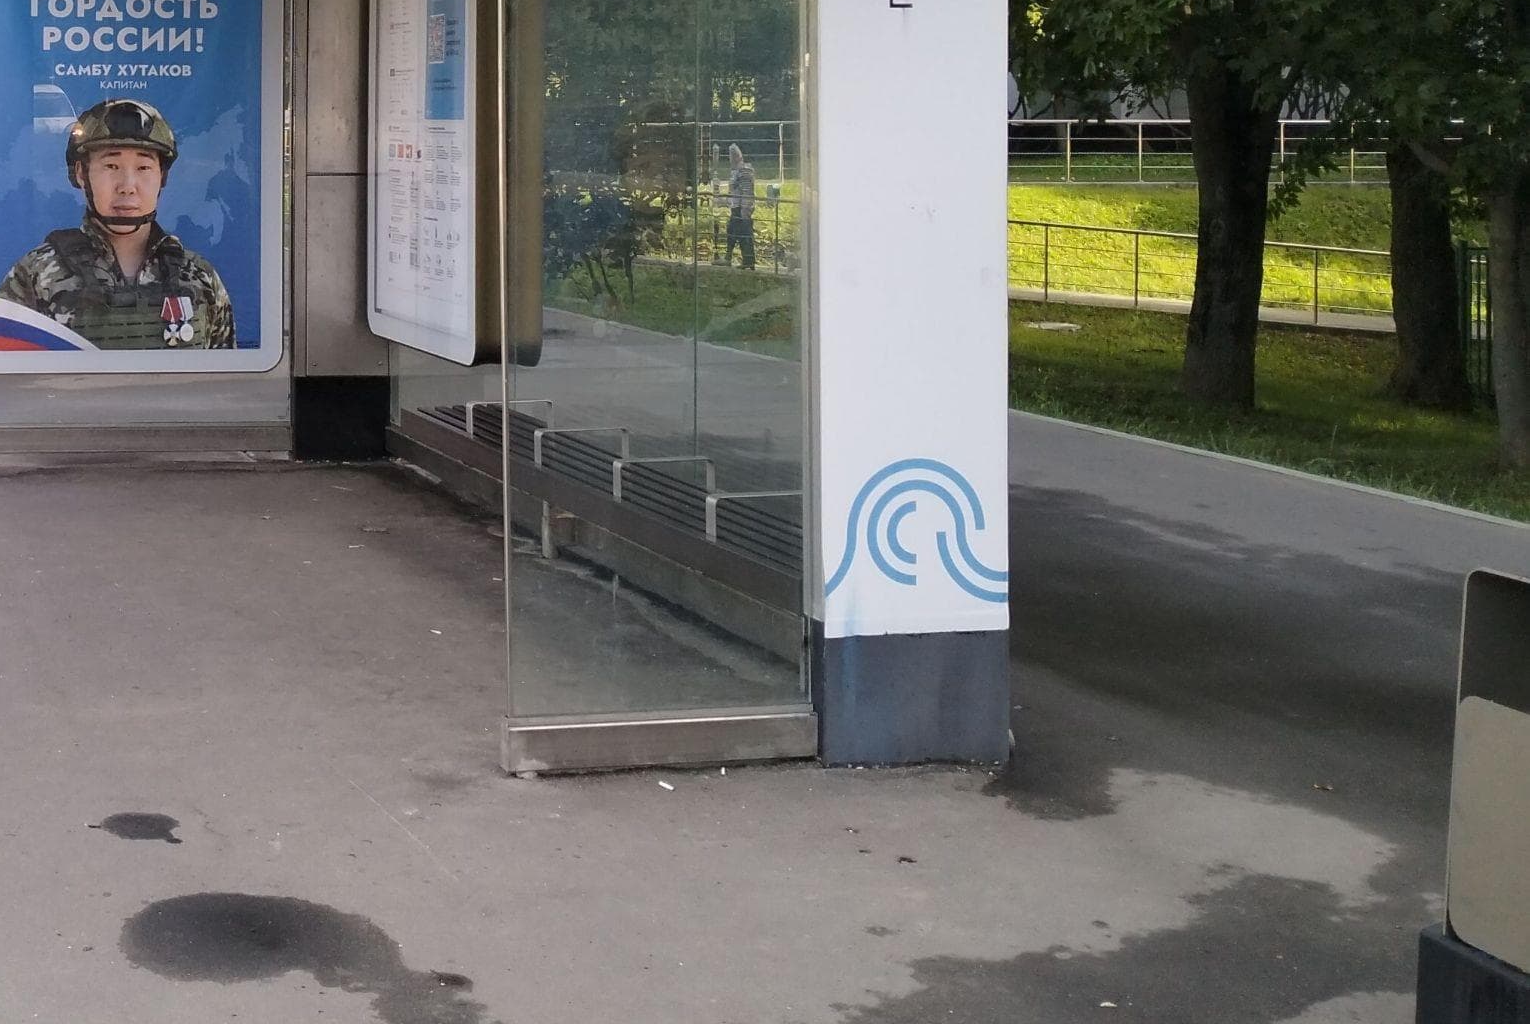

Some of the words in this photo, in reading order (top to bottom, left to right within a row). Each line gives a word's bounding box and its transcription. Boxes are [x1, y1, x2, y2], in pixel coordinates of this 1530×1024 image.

[42, 26, 204, 53] РОССИИ!
[54, 63, 112, 77] САМБУ
[117, 63, 192, 78] ХУТАКОВ
[99, 80, 148, 90] КАПИТАН
